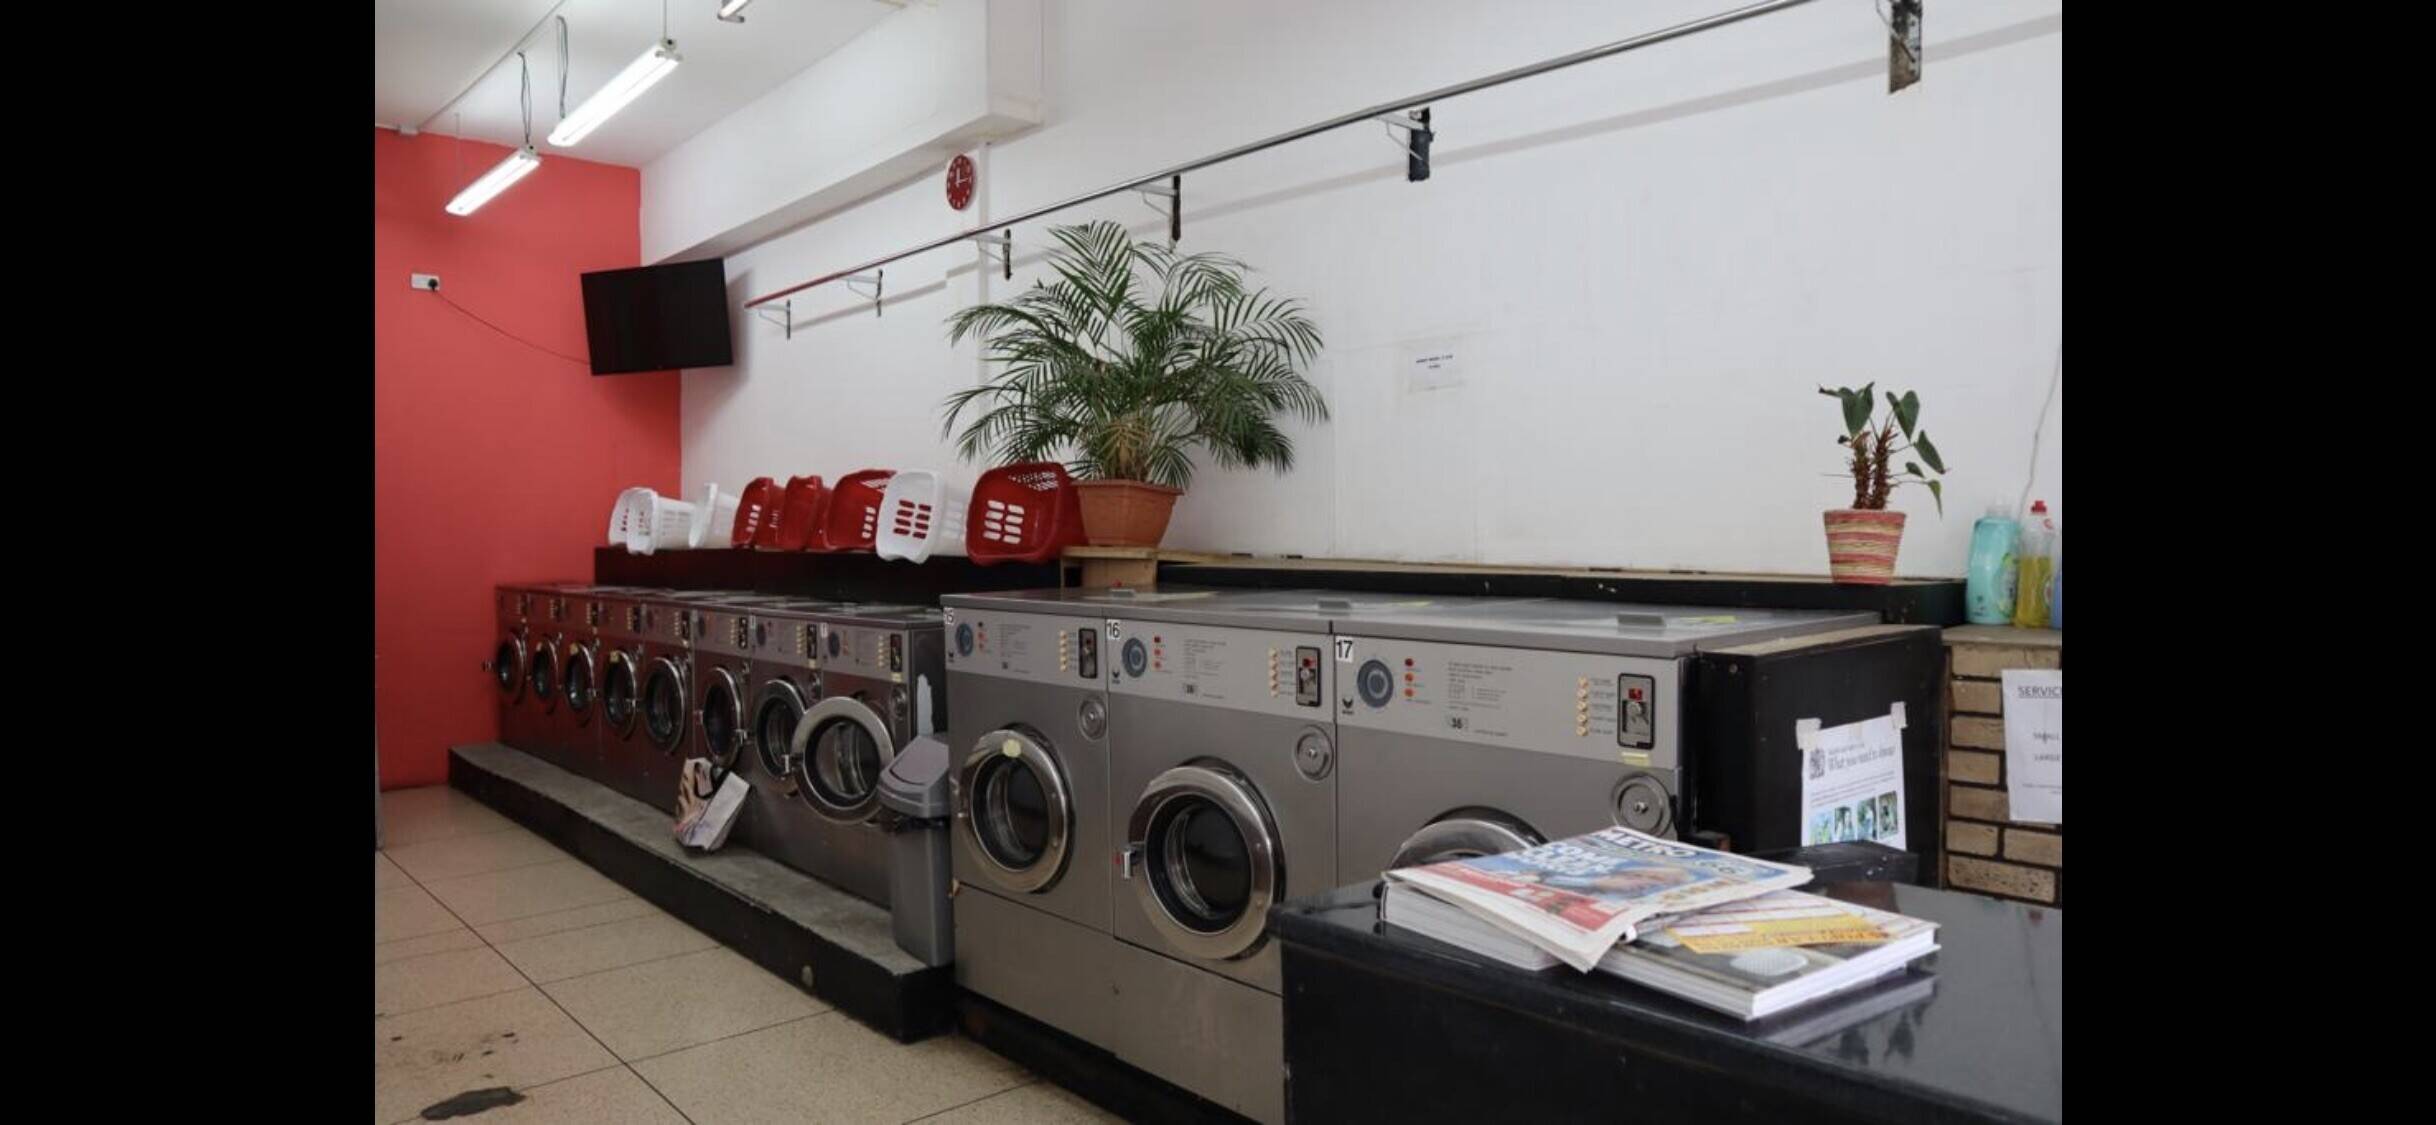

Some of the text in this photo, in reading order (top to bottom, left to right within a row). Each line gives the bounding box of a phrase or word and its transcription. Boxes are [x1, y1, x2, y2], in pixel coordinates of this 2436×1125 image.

[944, 610, 954, 624] 15
[1107, 622, 1120, 639] 16
[1336, 640, 1353, 659] 17
[1597, 829, 1698, 858] METRO
